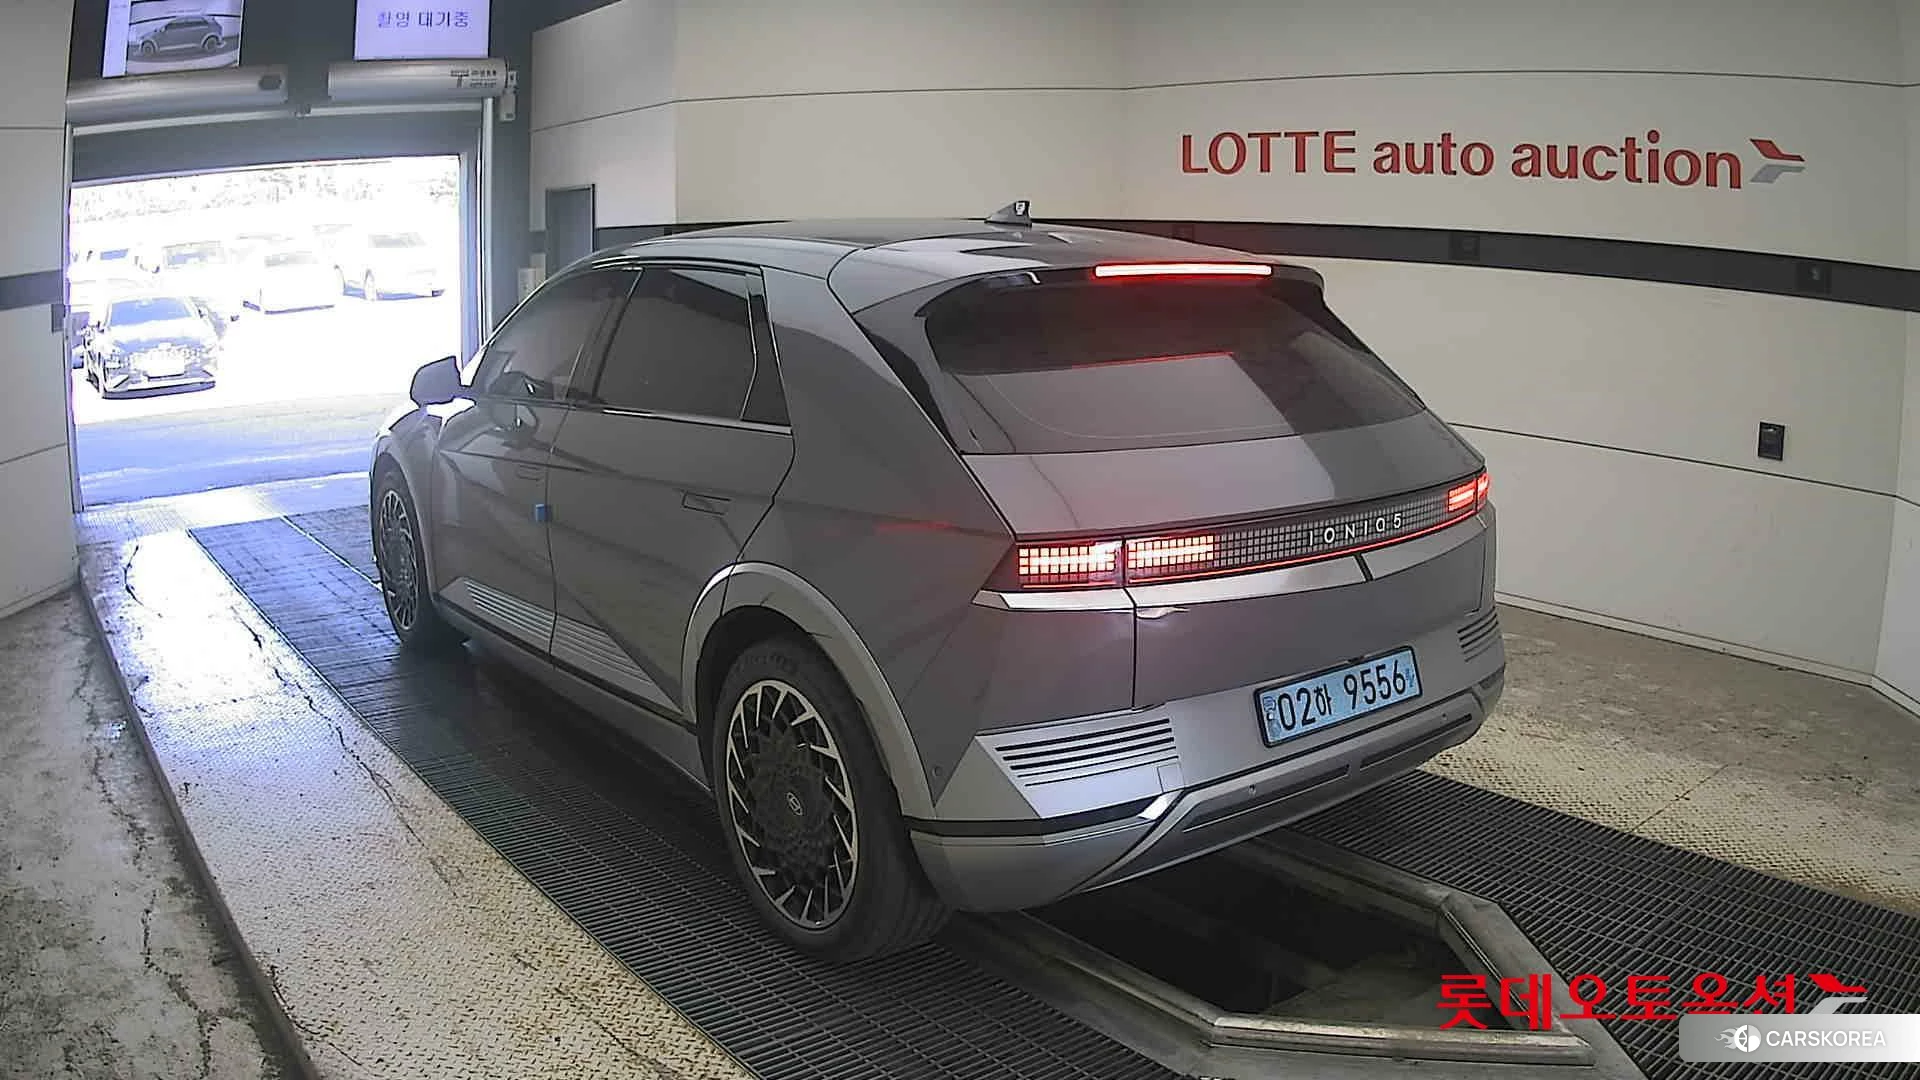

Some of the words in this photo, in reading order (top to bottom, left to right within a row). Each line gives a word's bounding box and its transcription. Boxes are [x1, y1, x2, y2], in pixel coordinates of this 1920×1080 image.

[418, 10, 469, 29] 대기중
[1181, 130, 1357, 175] LOTTE
[1373, 132, 1495, 176] auto
[1511, 129, 1742, 189] auction
[1277, 683, 1332, 731] 02하
[1343, 659, 1406, 710] 9556
